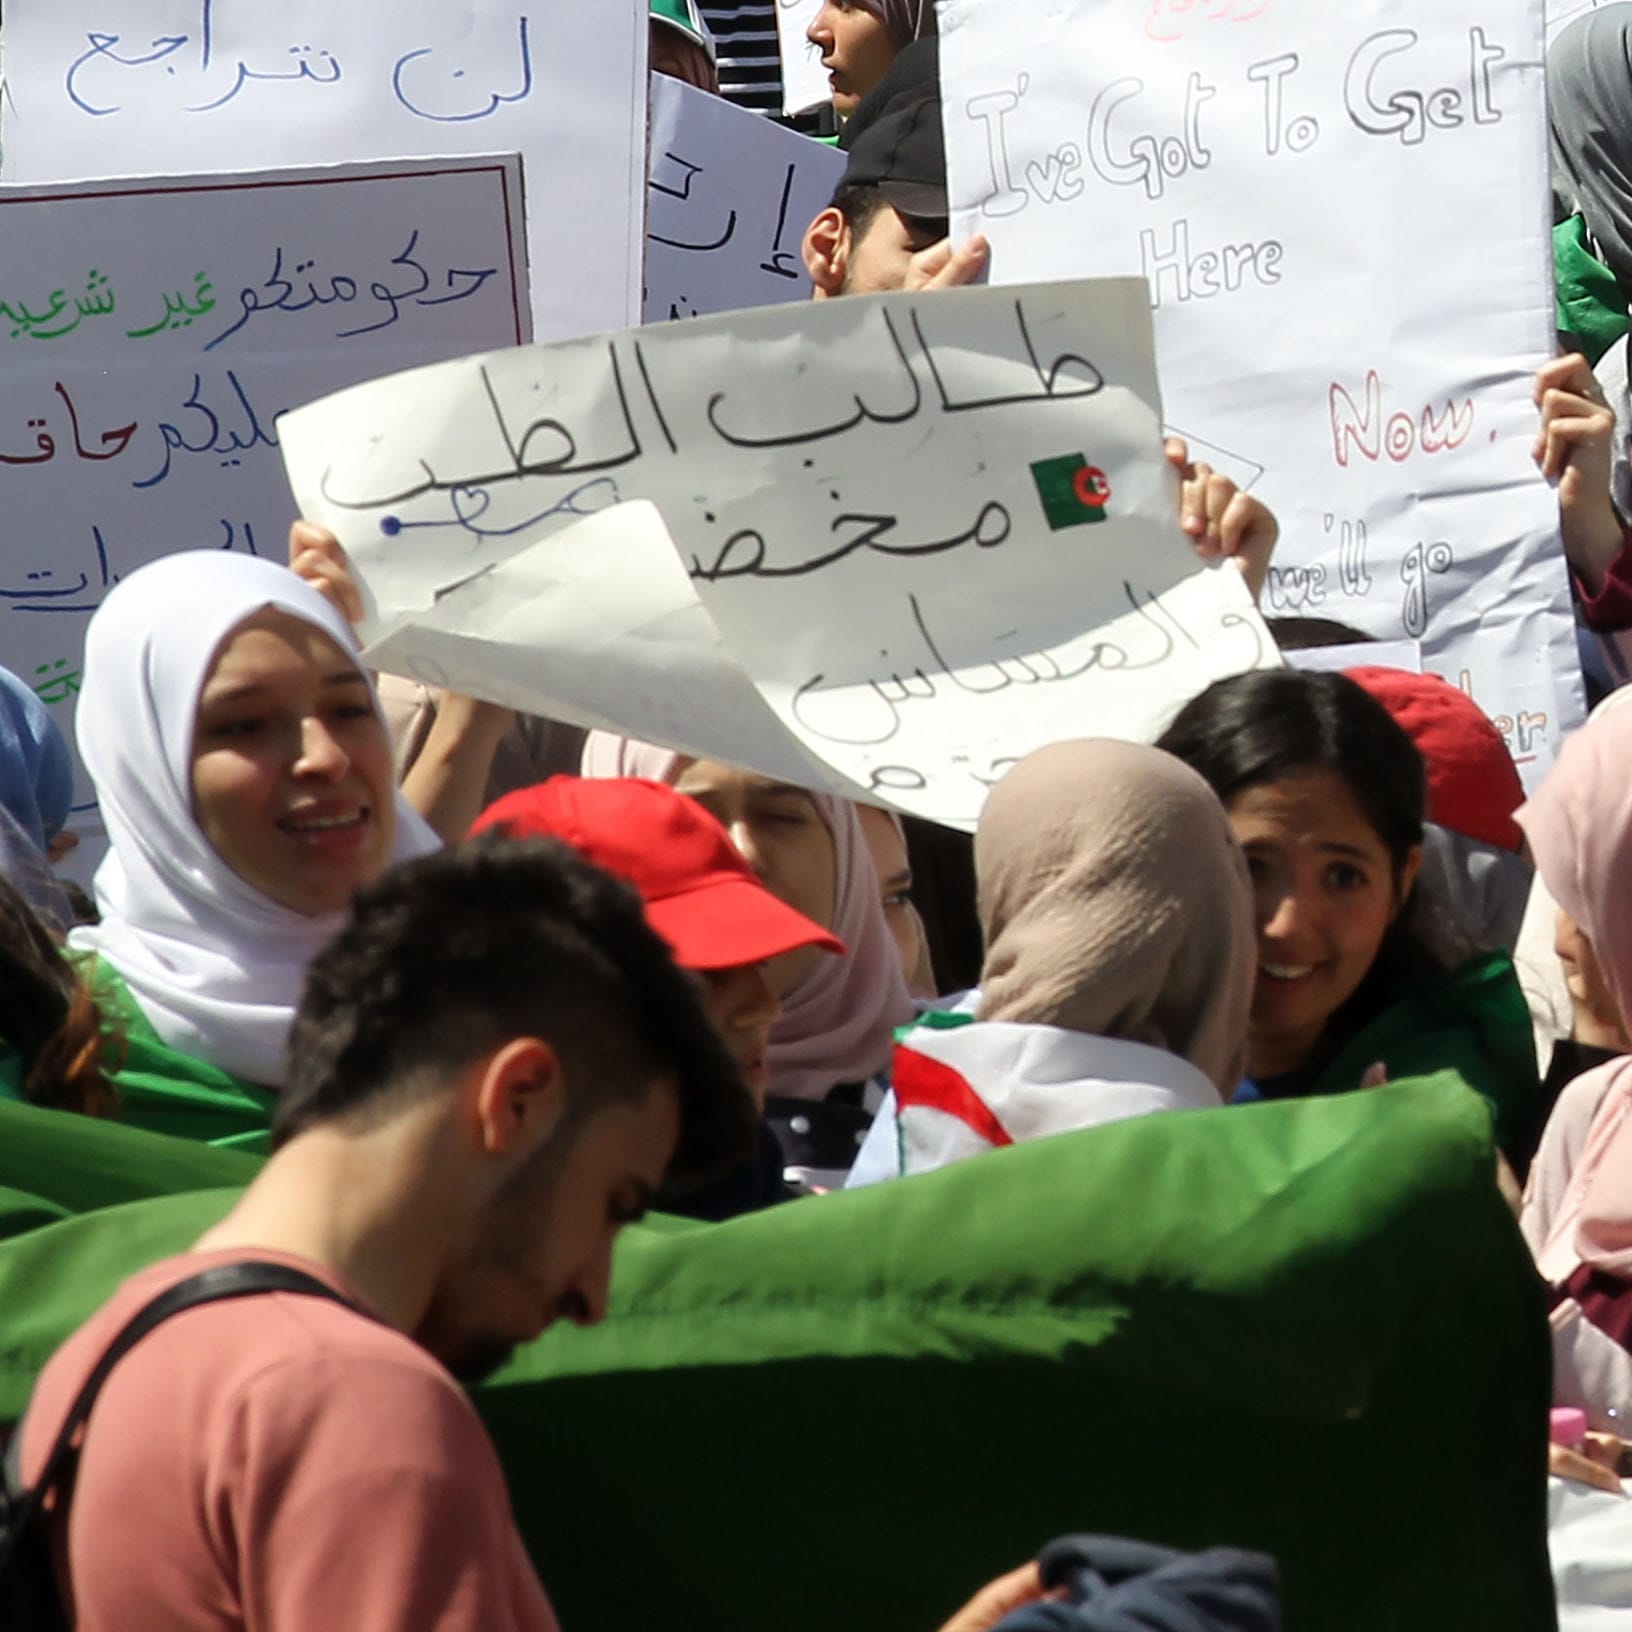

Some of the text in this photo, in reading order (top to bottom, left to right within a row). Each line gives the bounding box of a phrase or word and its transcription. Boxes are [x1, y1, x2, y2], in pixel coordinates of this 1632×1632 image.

[394, 18, 532, 123] لن
[967, 25, 1505, 218] I've Got To Get
[127, 271, 217, 338] غير
[1139, 220, 1283, 308] Here
[708, 298, 1105, 467] طالب
[1401, 542, 1453, 637] go
